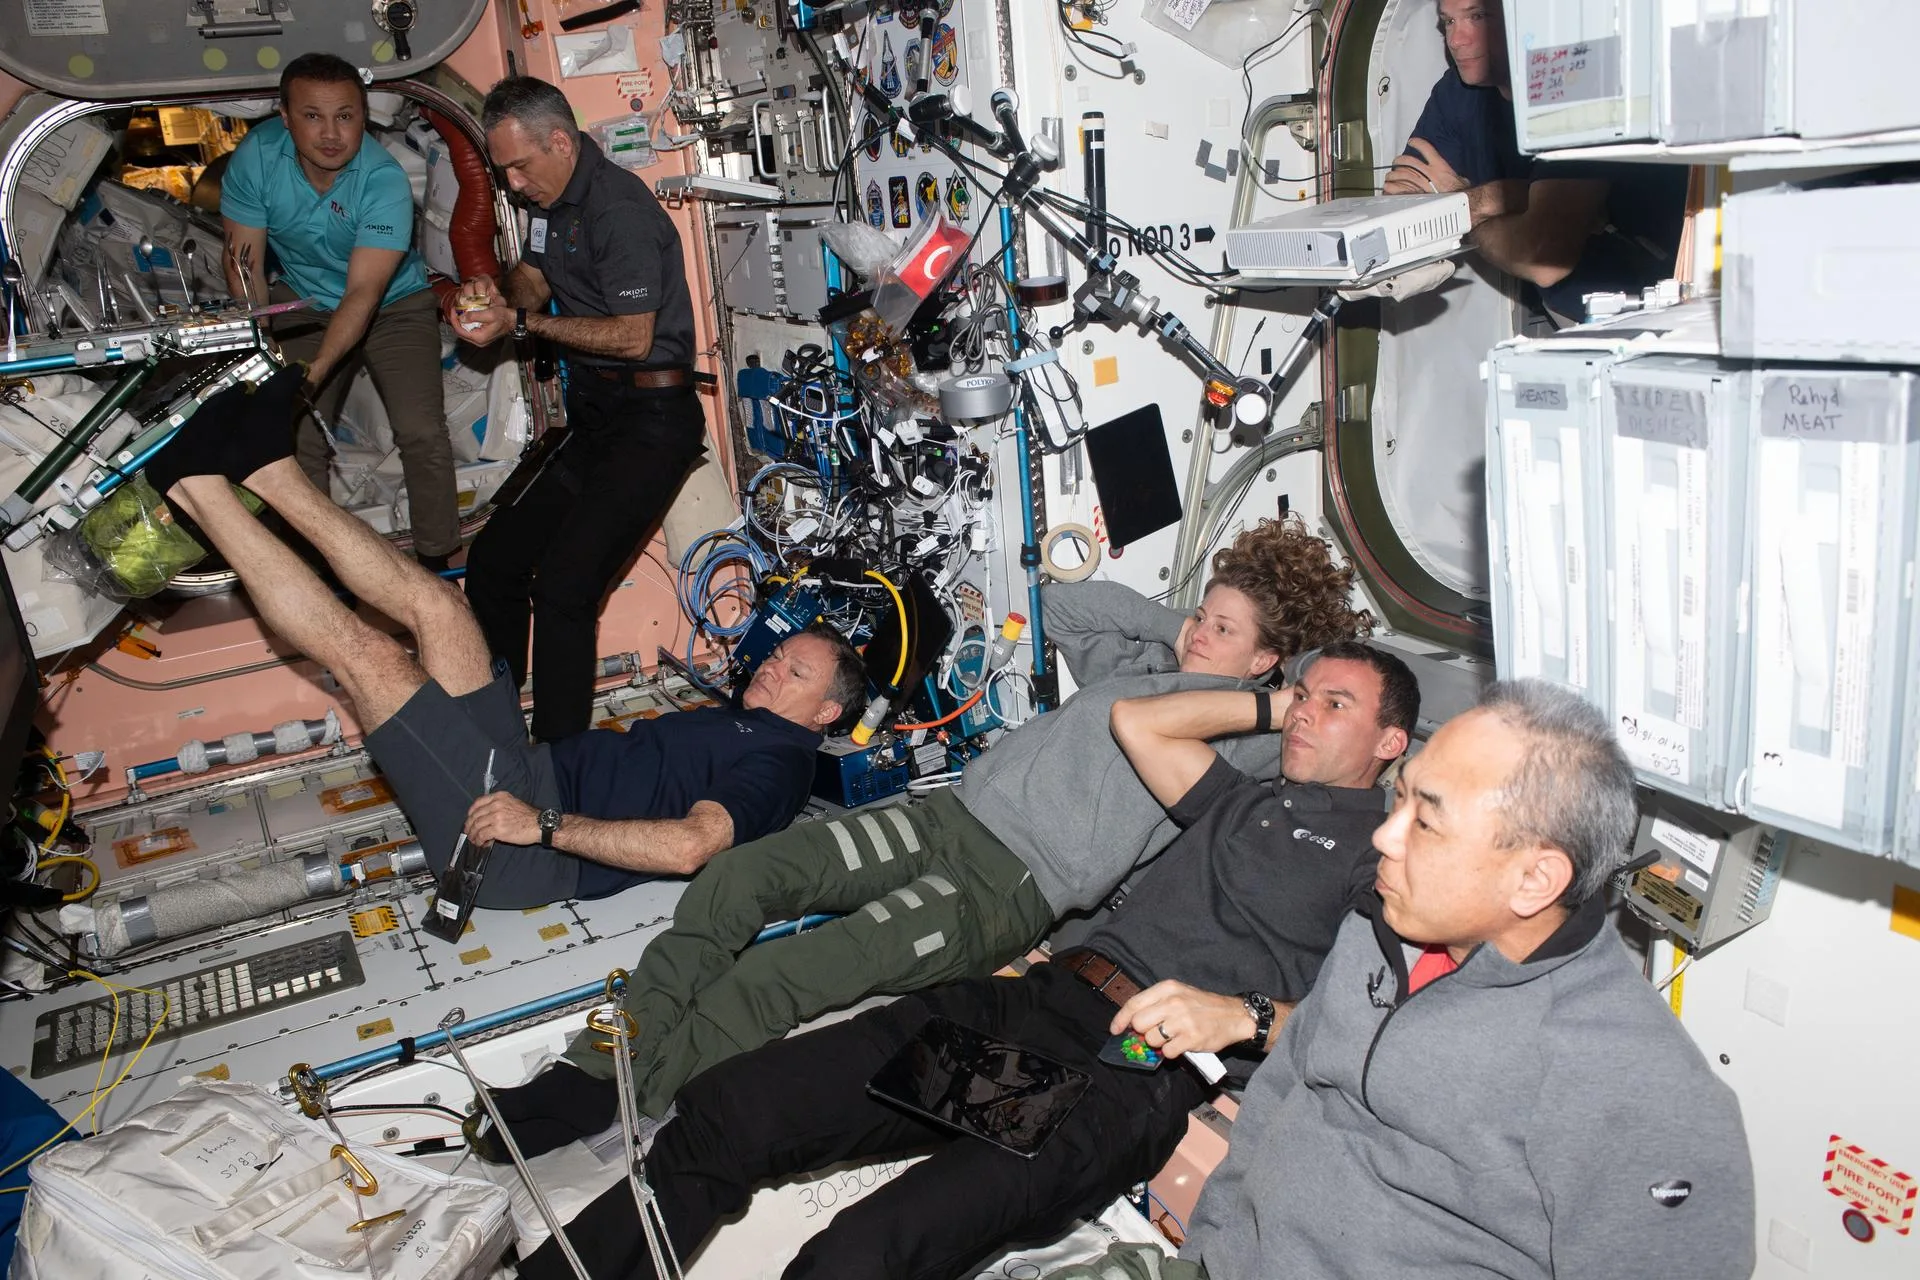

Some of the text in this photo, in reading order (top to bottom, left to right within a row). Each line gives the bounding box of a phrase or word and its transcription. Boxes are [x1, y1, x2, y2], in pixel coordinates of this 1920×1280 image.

[364, 224, 394, 232] AXIOM
[1180, 223, 1191, 251] 3
[618, 287, 648, 297] AXIOM
[1788, 383, 1840, 412] Rehyd
[1783, 412, 1843, 431] MEAT
[1838, 1148, 1887, 1180] EMERGENCY
[1836, 1163, 1902, 1206] FIRE PORT
